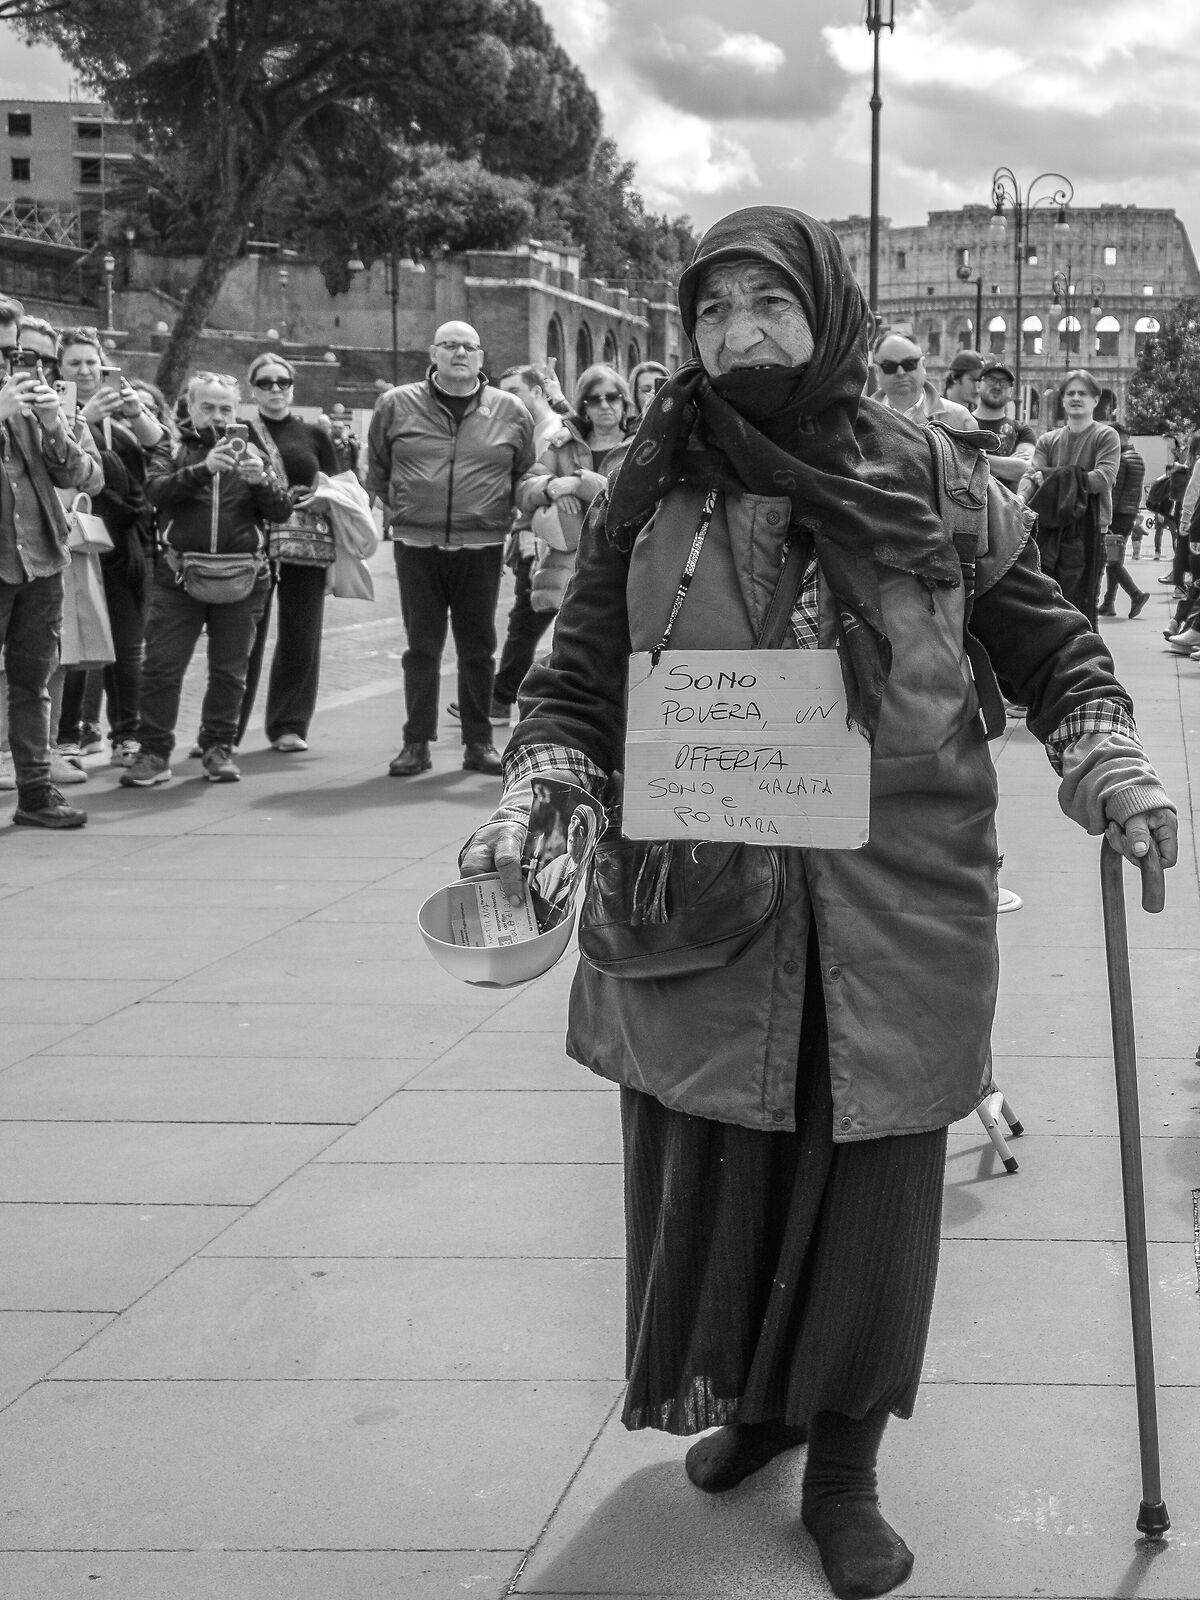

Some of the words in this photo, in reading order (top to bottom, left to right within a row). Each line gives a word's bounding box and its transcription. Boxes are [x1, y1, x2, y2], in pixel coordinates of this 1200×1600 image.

[664, 664, 757, 691] SONO
[796, 700, 839, 724] UN
[675, 744, 788, 771] OFFERTA
[648, 777, 715, 799] SONO
